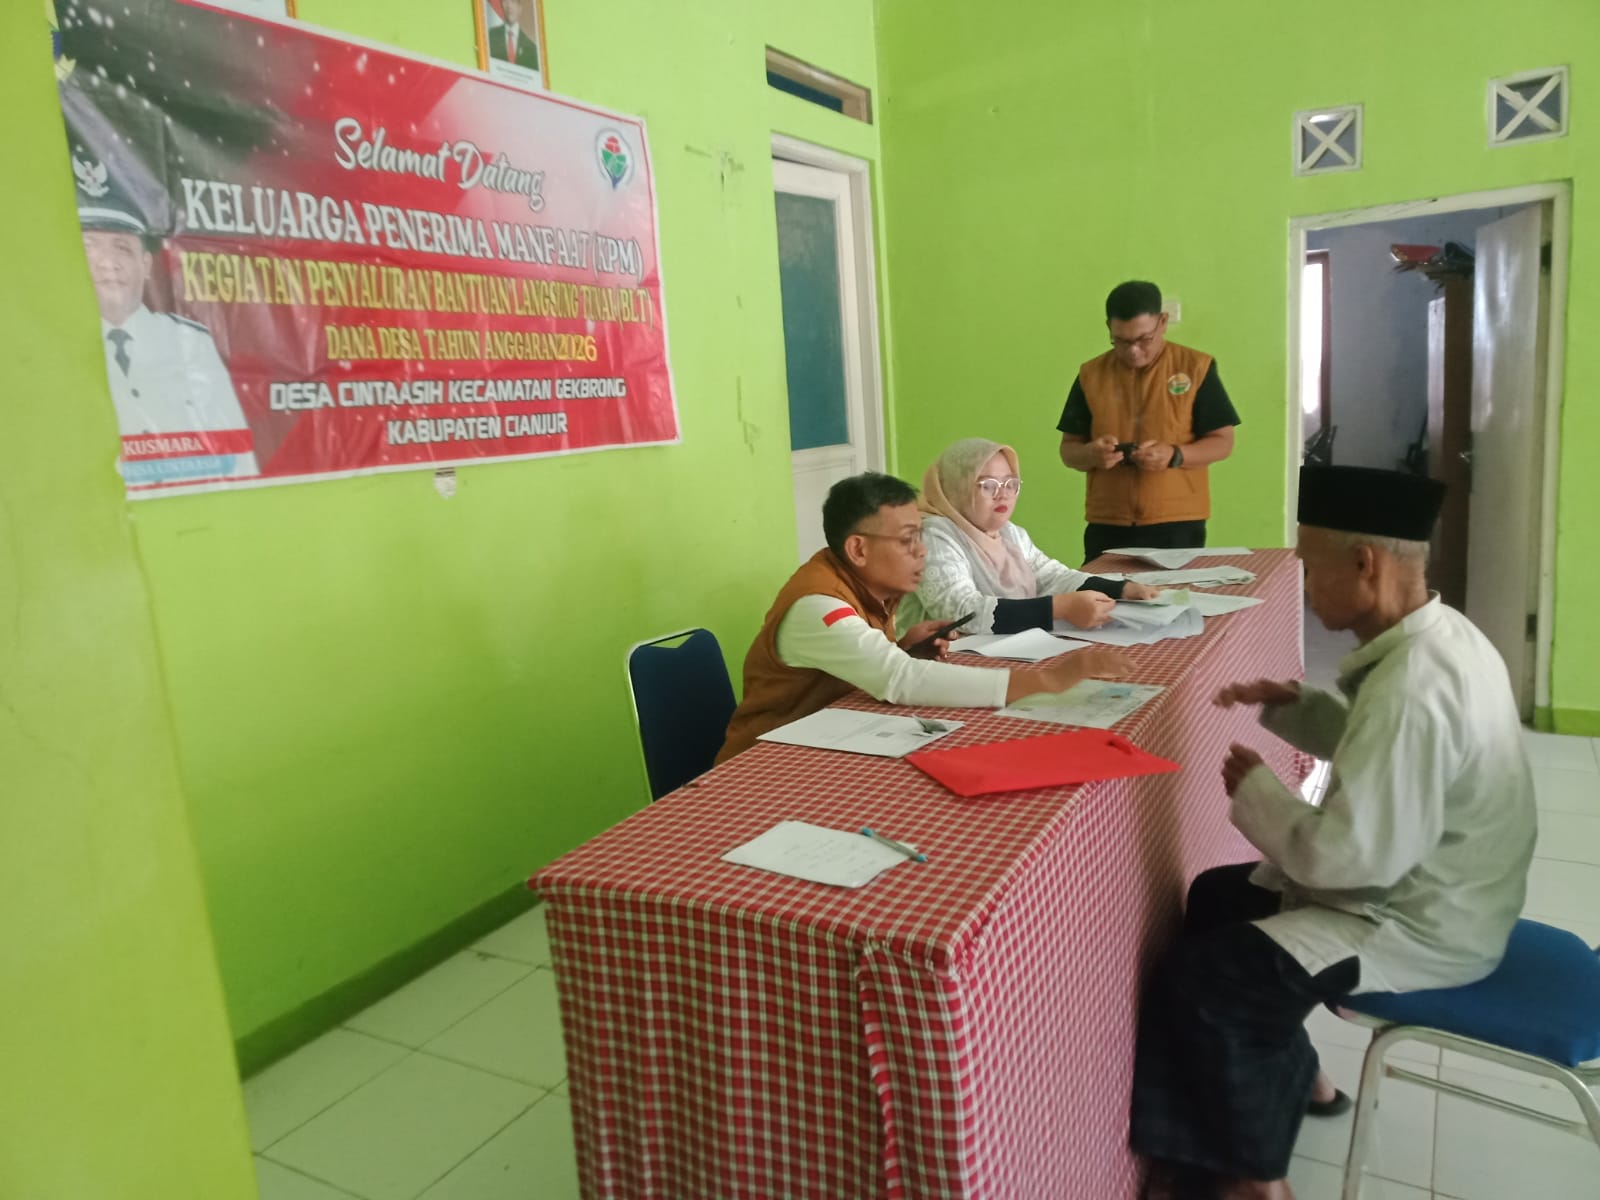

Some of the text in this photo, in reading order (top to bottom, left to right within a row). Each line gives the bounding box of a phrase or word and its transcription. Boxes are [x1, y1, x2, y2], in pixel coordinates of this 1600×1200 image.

[334, 117, 546, 213] Selamat Datang
[181, 178, 644, 286] KELUARGA PENERIMA MANFAAT (KPM)
[180, 251, 306, 305] KEGIATAN
[304, 259, 432, 312] PENYALURAN
[431, 270, 513, 316] BANTUAN
[511, 277, 579, 320] LANGSUNG
[325, 324, 598, 362] DANA DESA TAHUN ANGGARAN 2026
[269, 377, 627, 411] DESA CINTAASIH KECAMATAN GEKBRONG
[122, 437, 204, 456] KUSMARA
[386, 412, 568, 445] KABUPATEN CIANJUR
